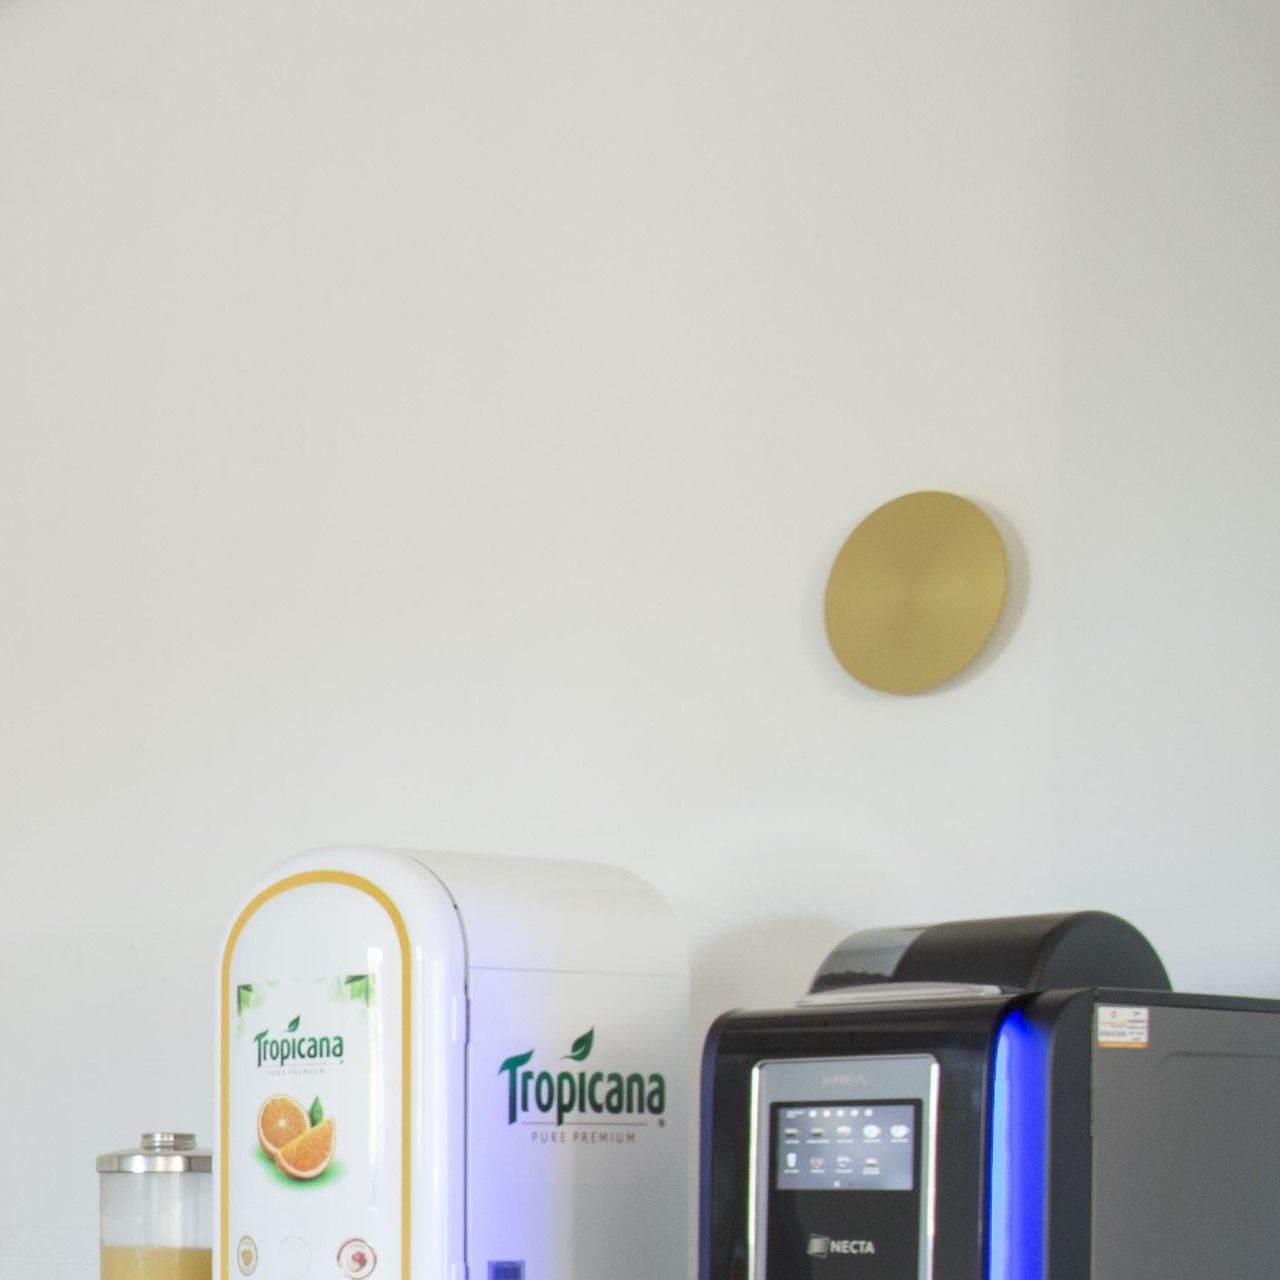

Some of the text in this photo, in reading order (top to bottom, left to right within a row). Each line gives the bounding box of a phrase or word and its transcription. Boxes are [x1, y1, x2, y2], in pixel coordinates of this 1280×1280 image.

[254, 1029, 344, 1068] Tropicana
[498, 1048, 666, 1127] Tropicana
[531, 1131, 636, 1145] PURE PREMIUM
[829, 1239, 876, 1255] NECTA
